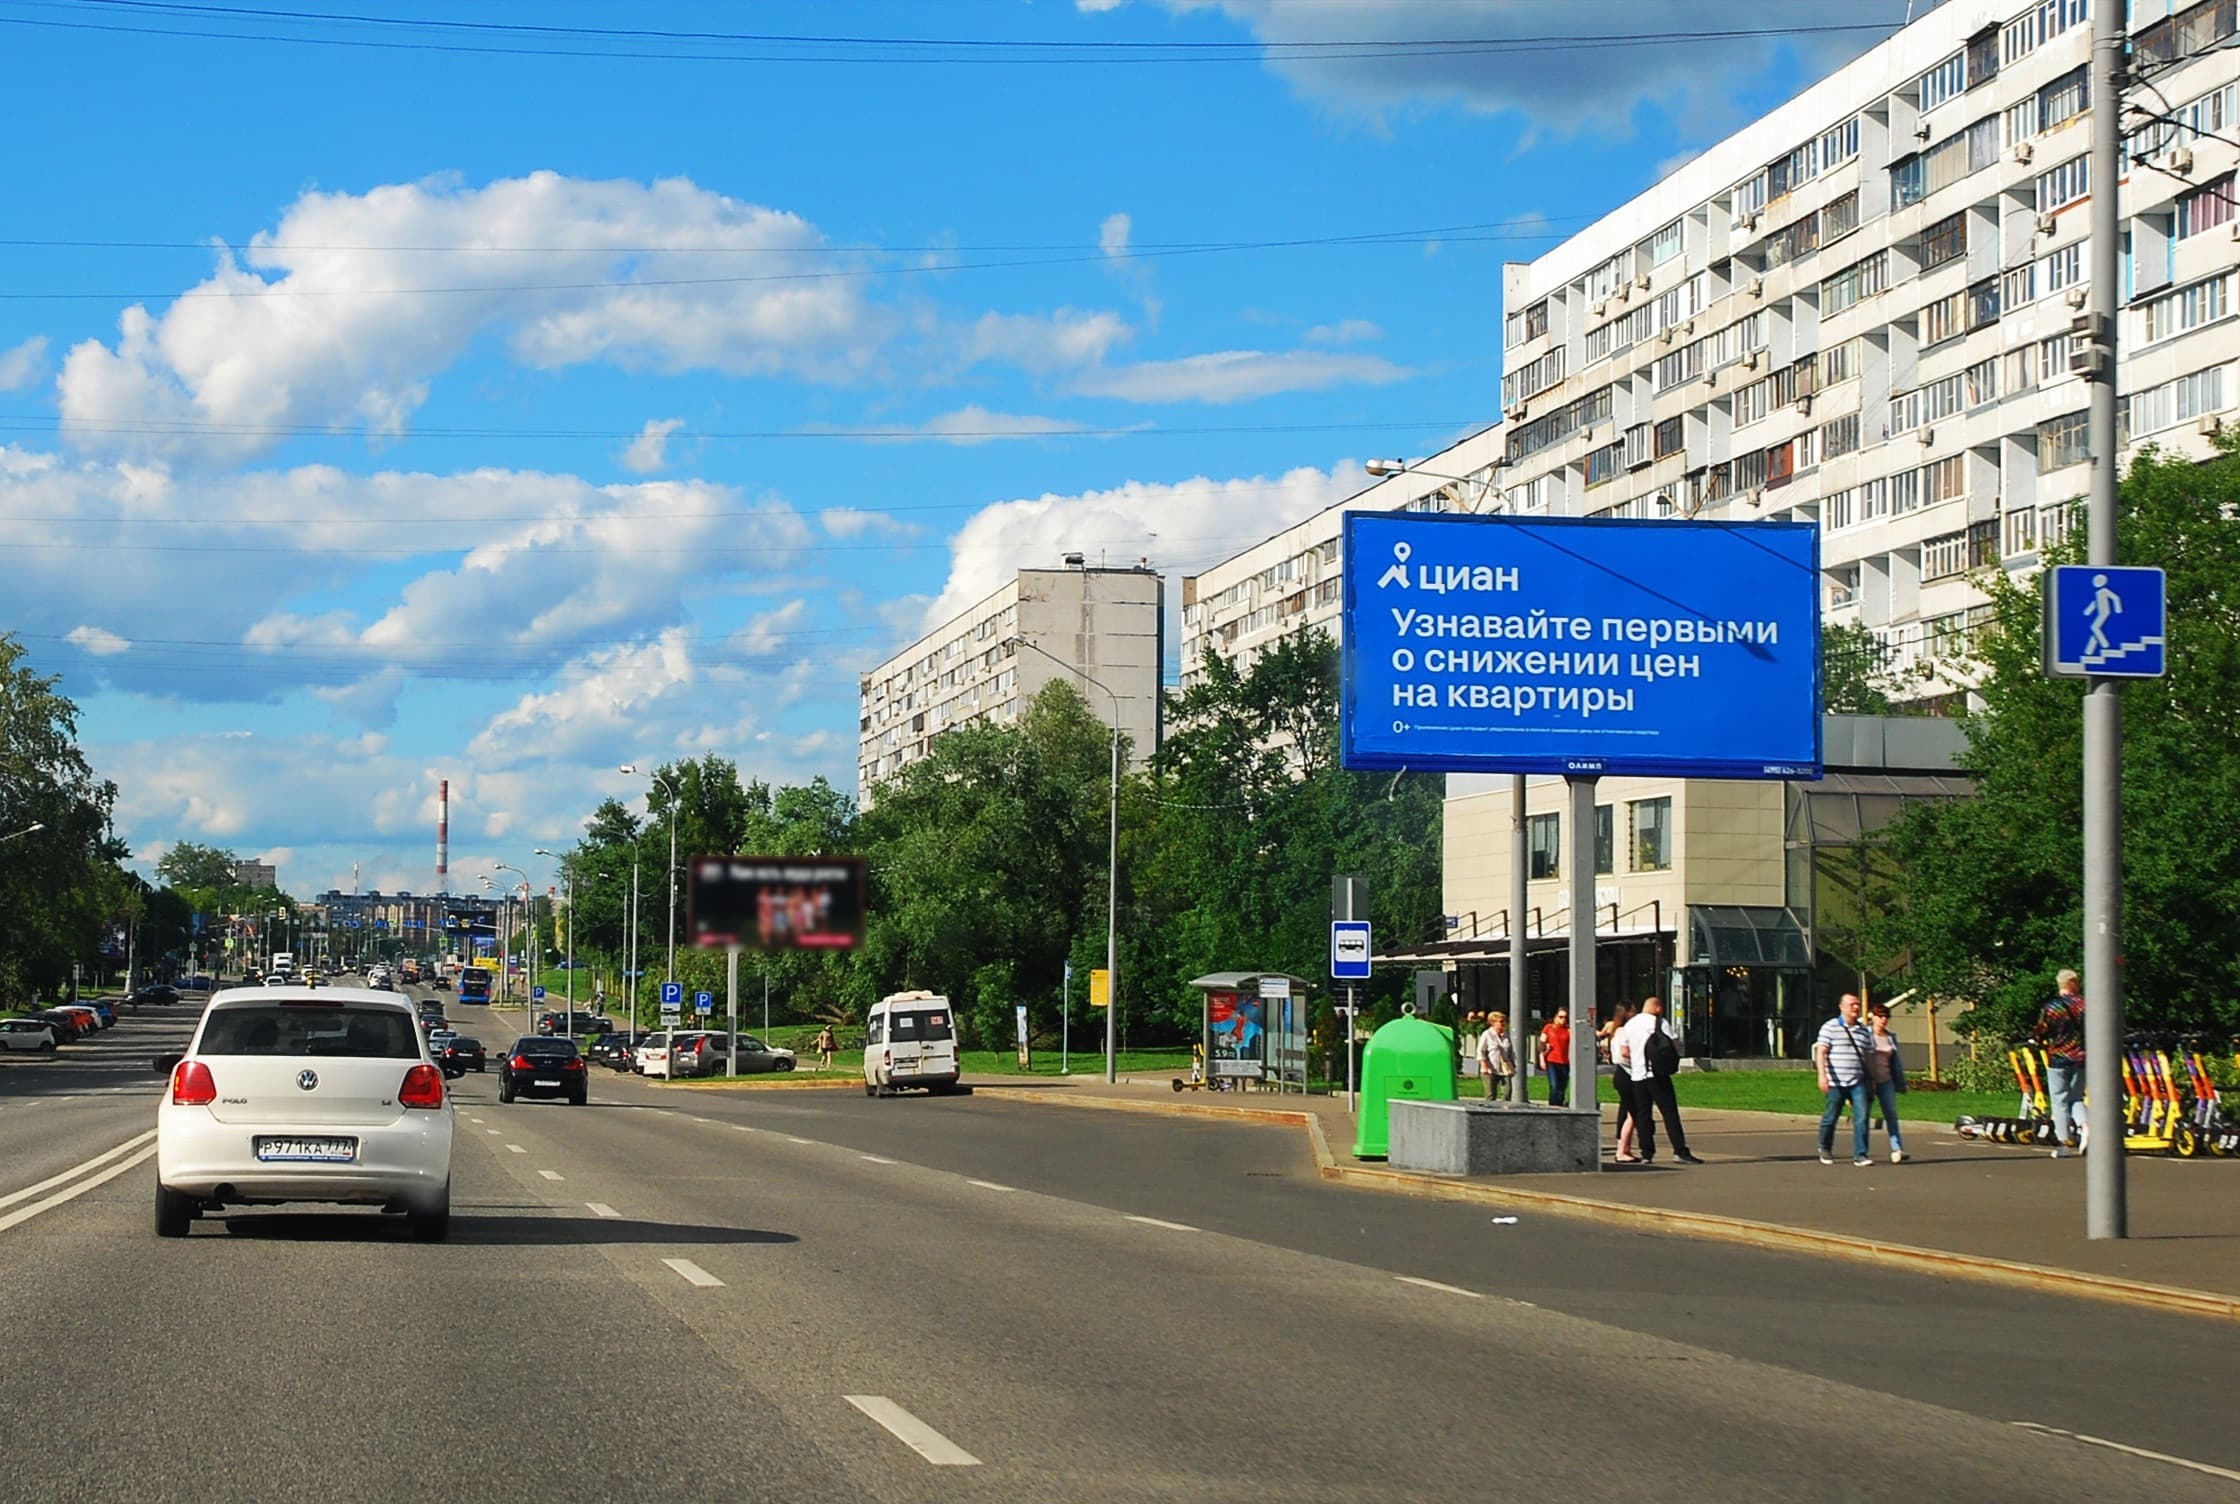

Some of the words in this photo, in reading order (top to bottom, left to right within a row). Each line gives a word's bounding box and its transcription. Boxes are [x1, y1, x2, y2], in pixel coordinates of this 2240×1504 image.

[1419, 565, 1519, 594] циан
[1391, 608, 1592, 641] Узнавайте
[1602, 618, 1778, 650] первыми
[1392, 648, 1415, 672] о
[1424, 649, 1619, 676] снижении
[1631, 654, 1701, 682] цен
[1392, 684, 1438, 708] на
[1448, 685, 1635, 718] квартиры
[1392, 720, 1411, 733] 0+
